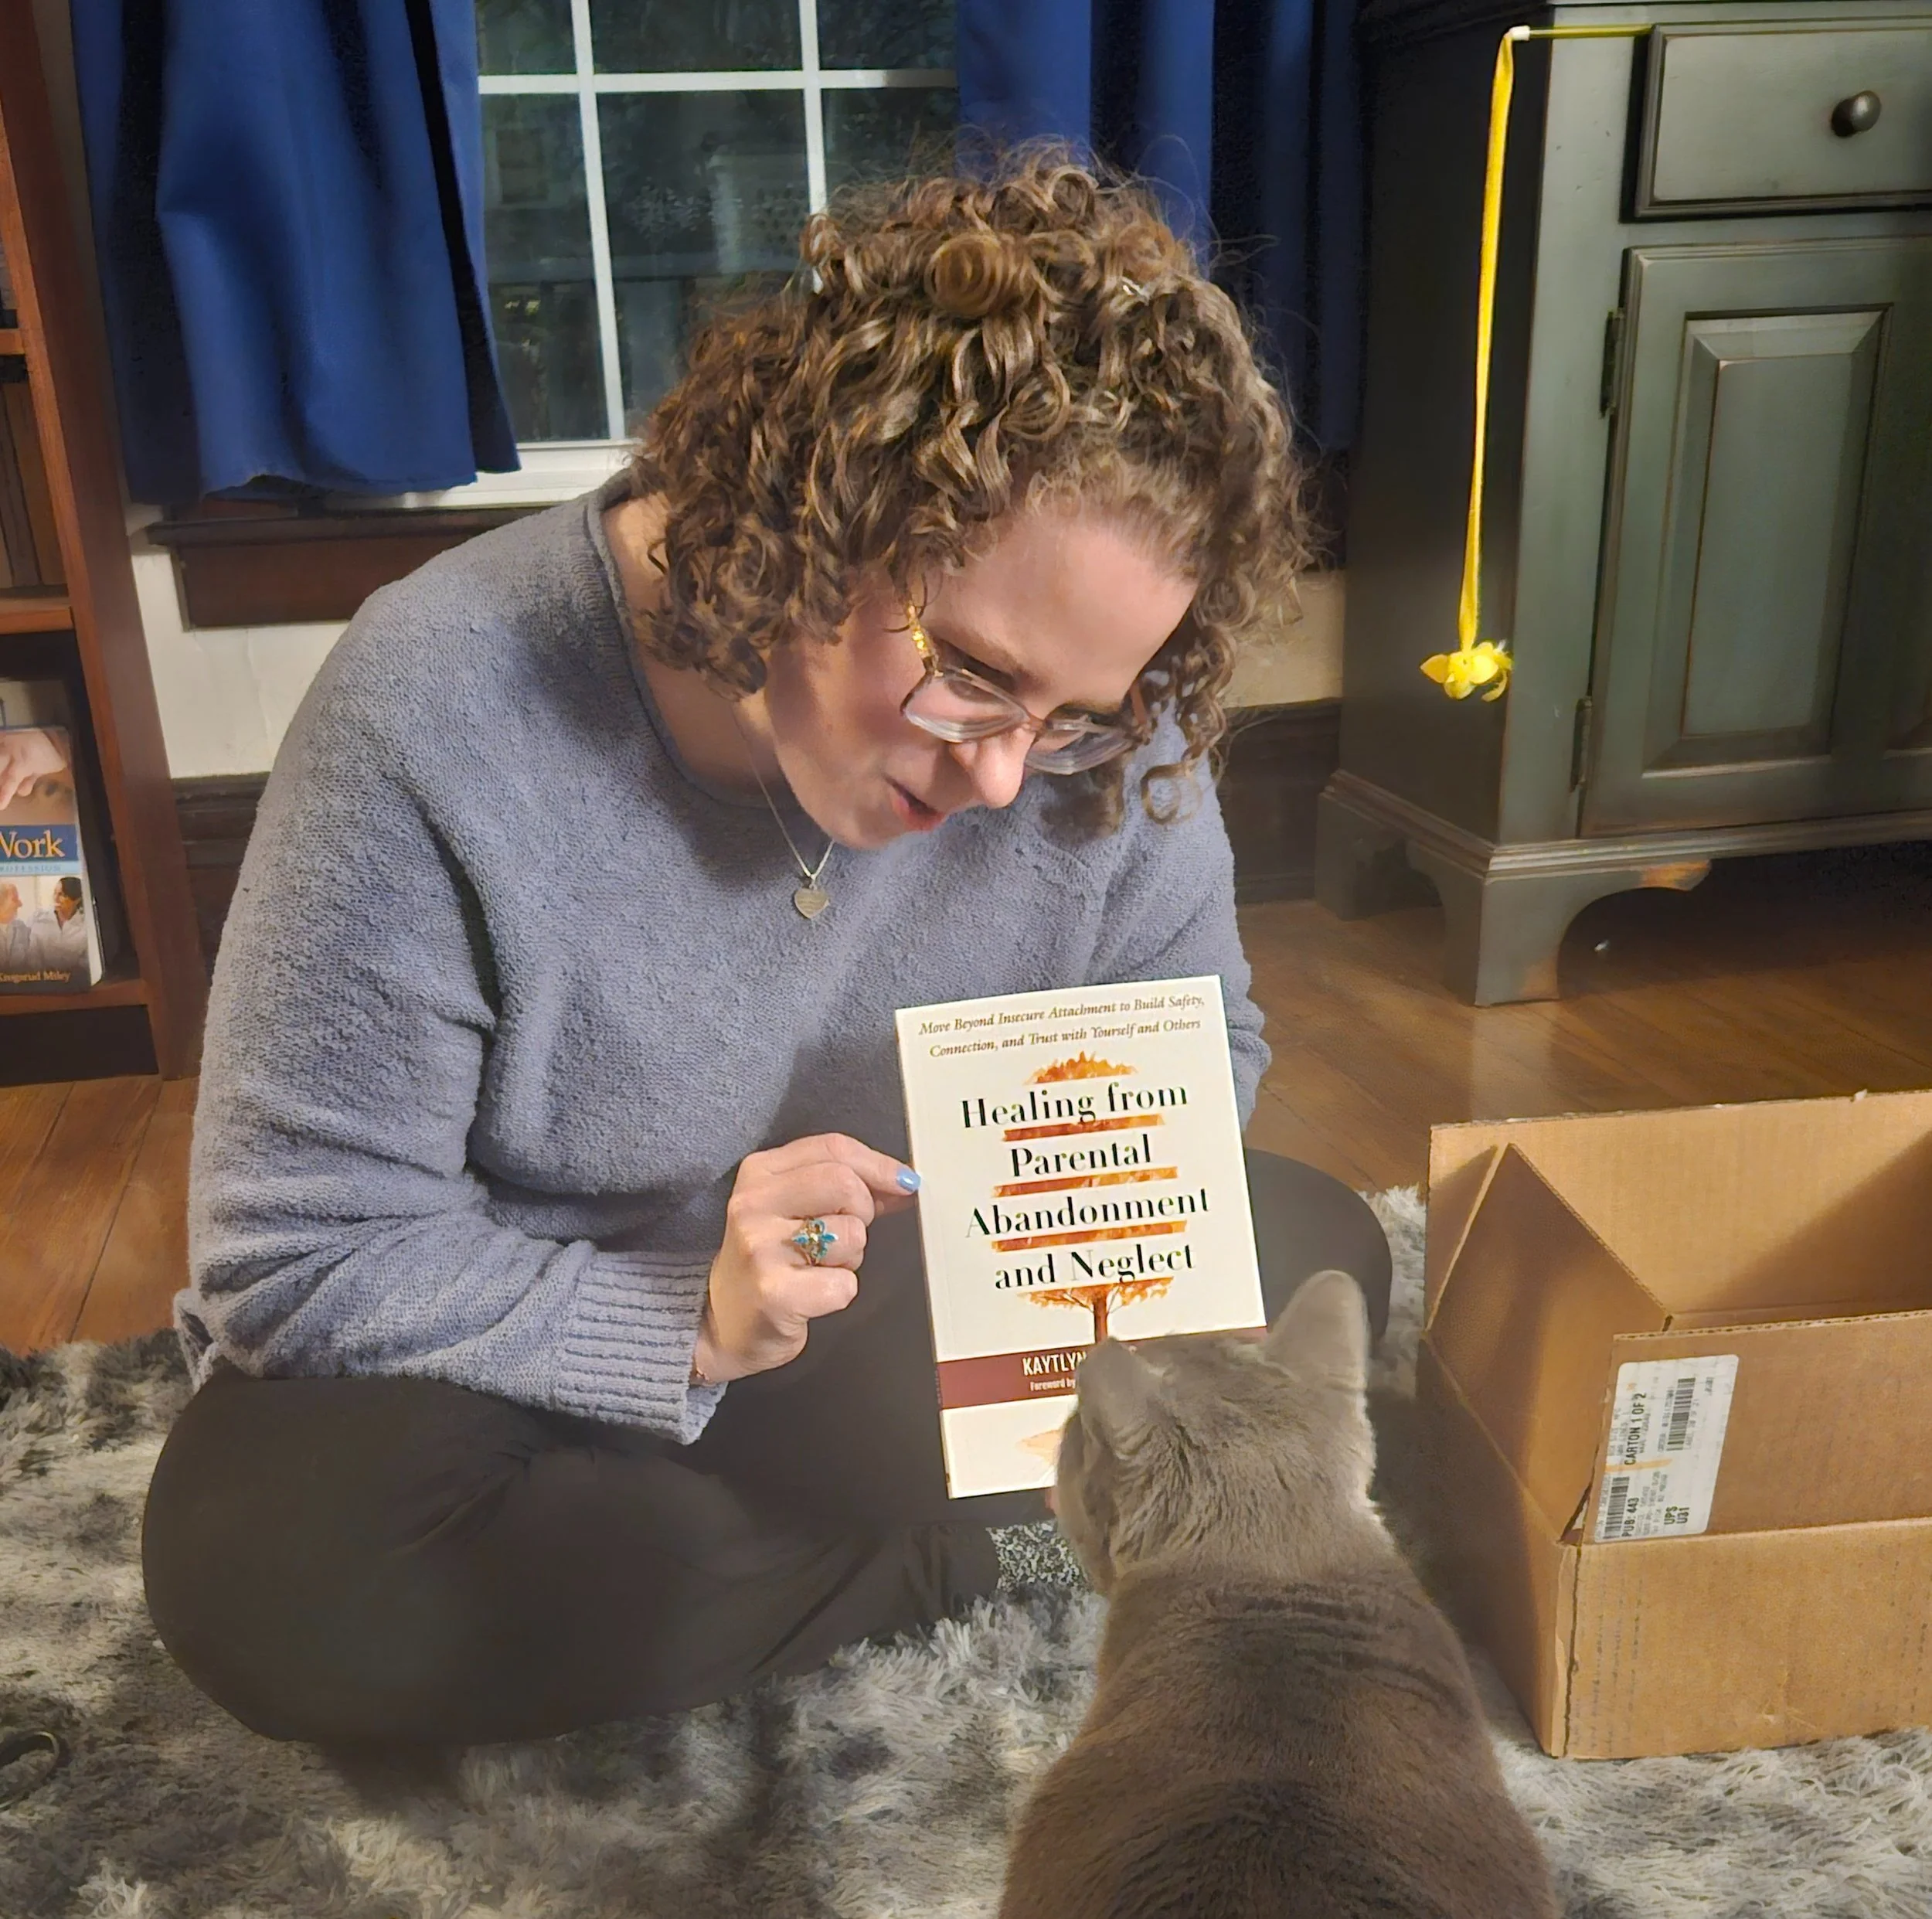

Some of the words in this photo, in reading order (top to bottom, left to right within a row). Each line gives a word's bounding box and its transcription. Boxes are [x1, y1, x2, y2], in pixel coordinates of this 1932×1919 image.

[919, 1022, 951, 1035] Move
[954, 1014, 995, 1033] Beyond
[998, 1010, 1045, 1025] Insecure
[1048, 1003, 1116, 1020] Attachment
[1121, 1003, 1131, 1012] to
[1134, 997, 1165, 1011] Build
[1168, 994, 1206, 1012] Safety,
[930, 1039, 998, 1057] Connection,
[1002, 1033, 1025, 1048] and
[1029, 1032, 1059, 1046] Trust
[1061, 1027, 1087, 1041] with
[1091, 1022, 1136, 1039] Yourself
[1138, 1022, 1160, 1034] and
[1163, 1019, 1201, 1032] Others
[960, 1089, 1097, 1128] Healing
[1107, 1082, 1190, 1112] from
[1009, 1134, 1153, 1176] Parental
[965, 1188, 1212, 1238] Abandonment
[995, 1254, 1056, 1289] and
[1070, 1244, 1196, 1283] Neglect
[1624, 1427, 1641, 1465] CARTON
[1633, 1402, 1645, 1414] OF
[1622, 1515, 1636, 1536] PUB:
[1628, 1497, 1639, 1513] 443
[1663, 1505, 1678, 1525] UPS
